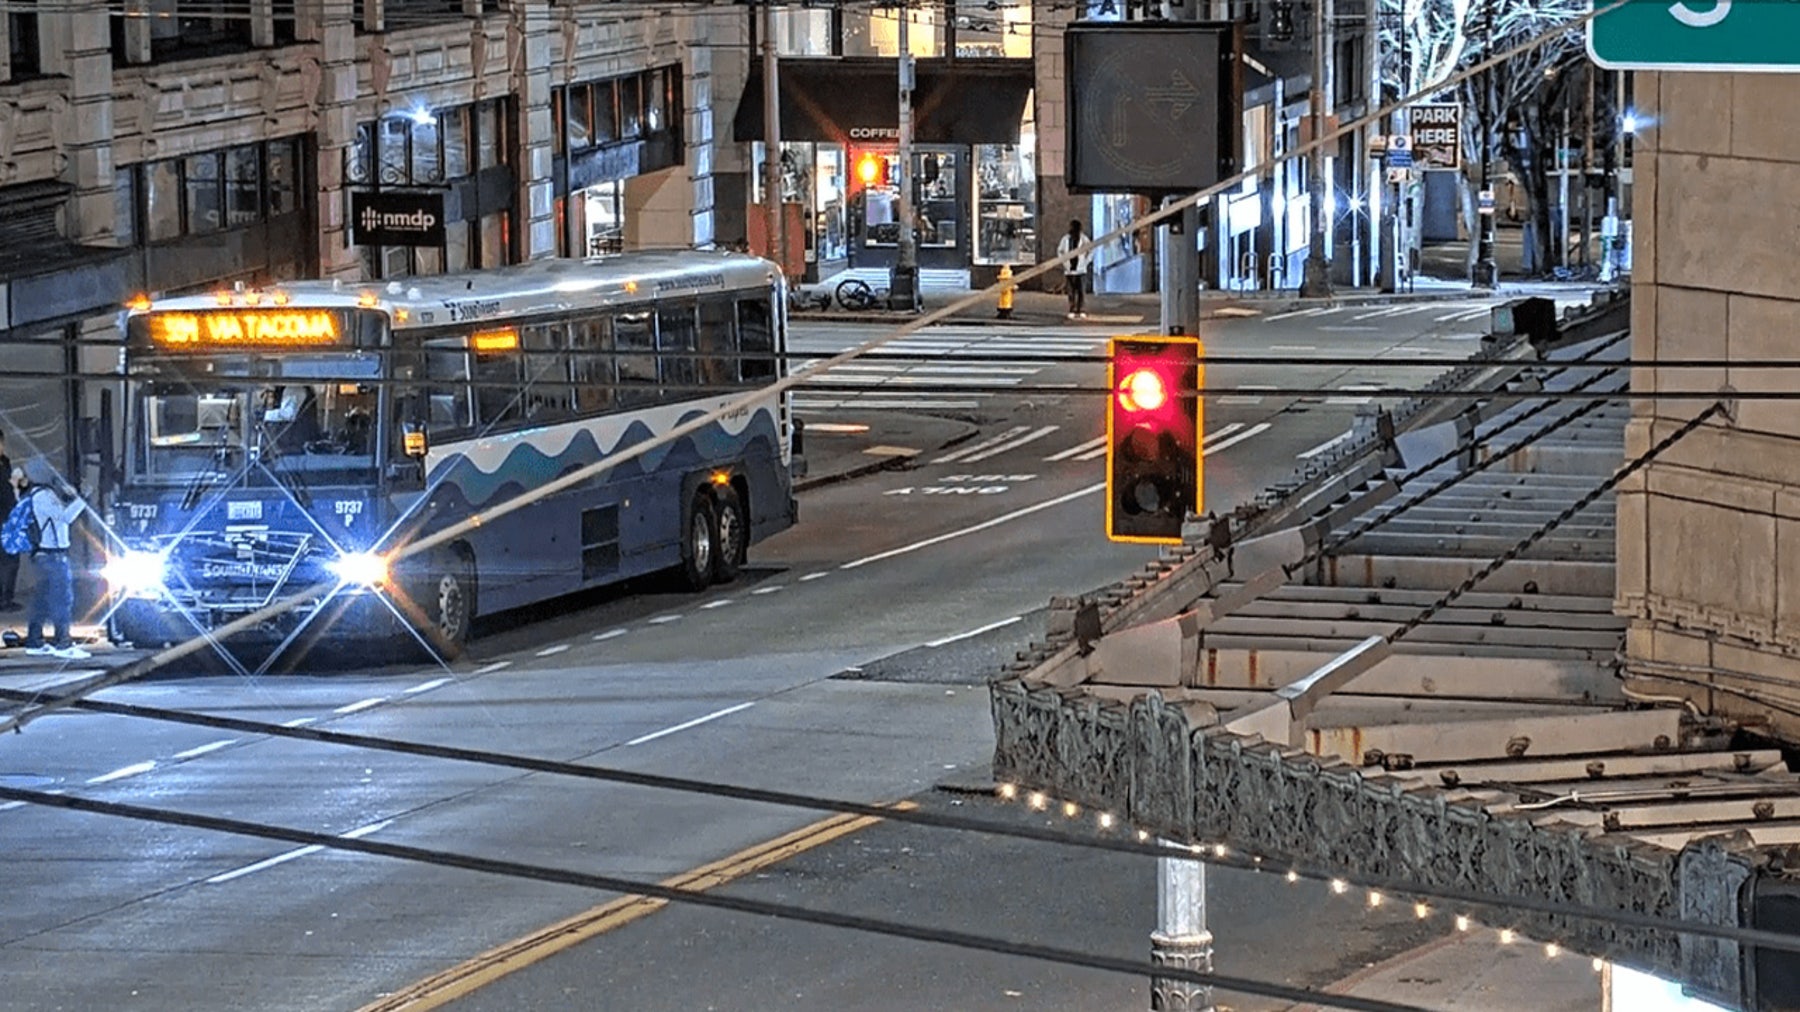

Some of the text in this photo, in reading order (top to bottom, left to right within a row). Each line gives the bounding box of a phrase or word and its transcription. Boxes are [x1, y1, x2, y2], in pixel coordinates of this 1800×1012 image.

[1412, 108, 1456, 123] PARK
[1413, 128, 1456, 144] HERE
[383, 209, 435, 232] nmdp
[206, 315, 243, 340] VIA
[244, 312, 334, 339] TACOMA
[131, 504, 158, 518] 9737
[335, 500, 363, 514] 9737
[345, 514, 354, 527] P
